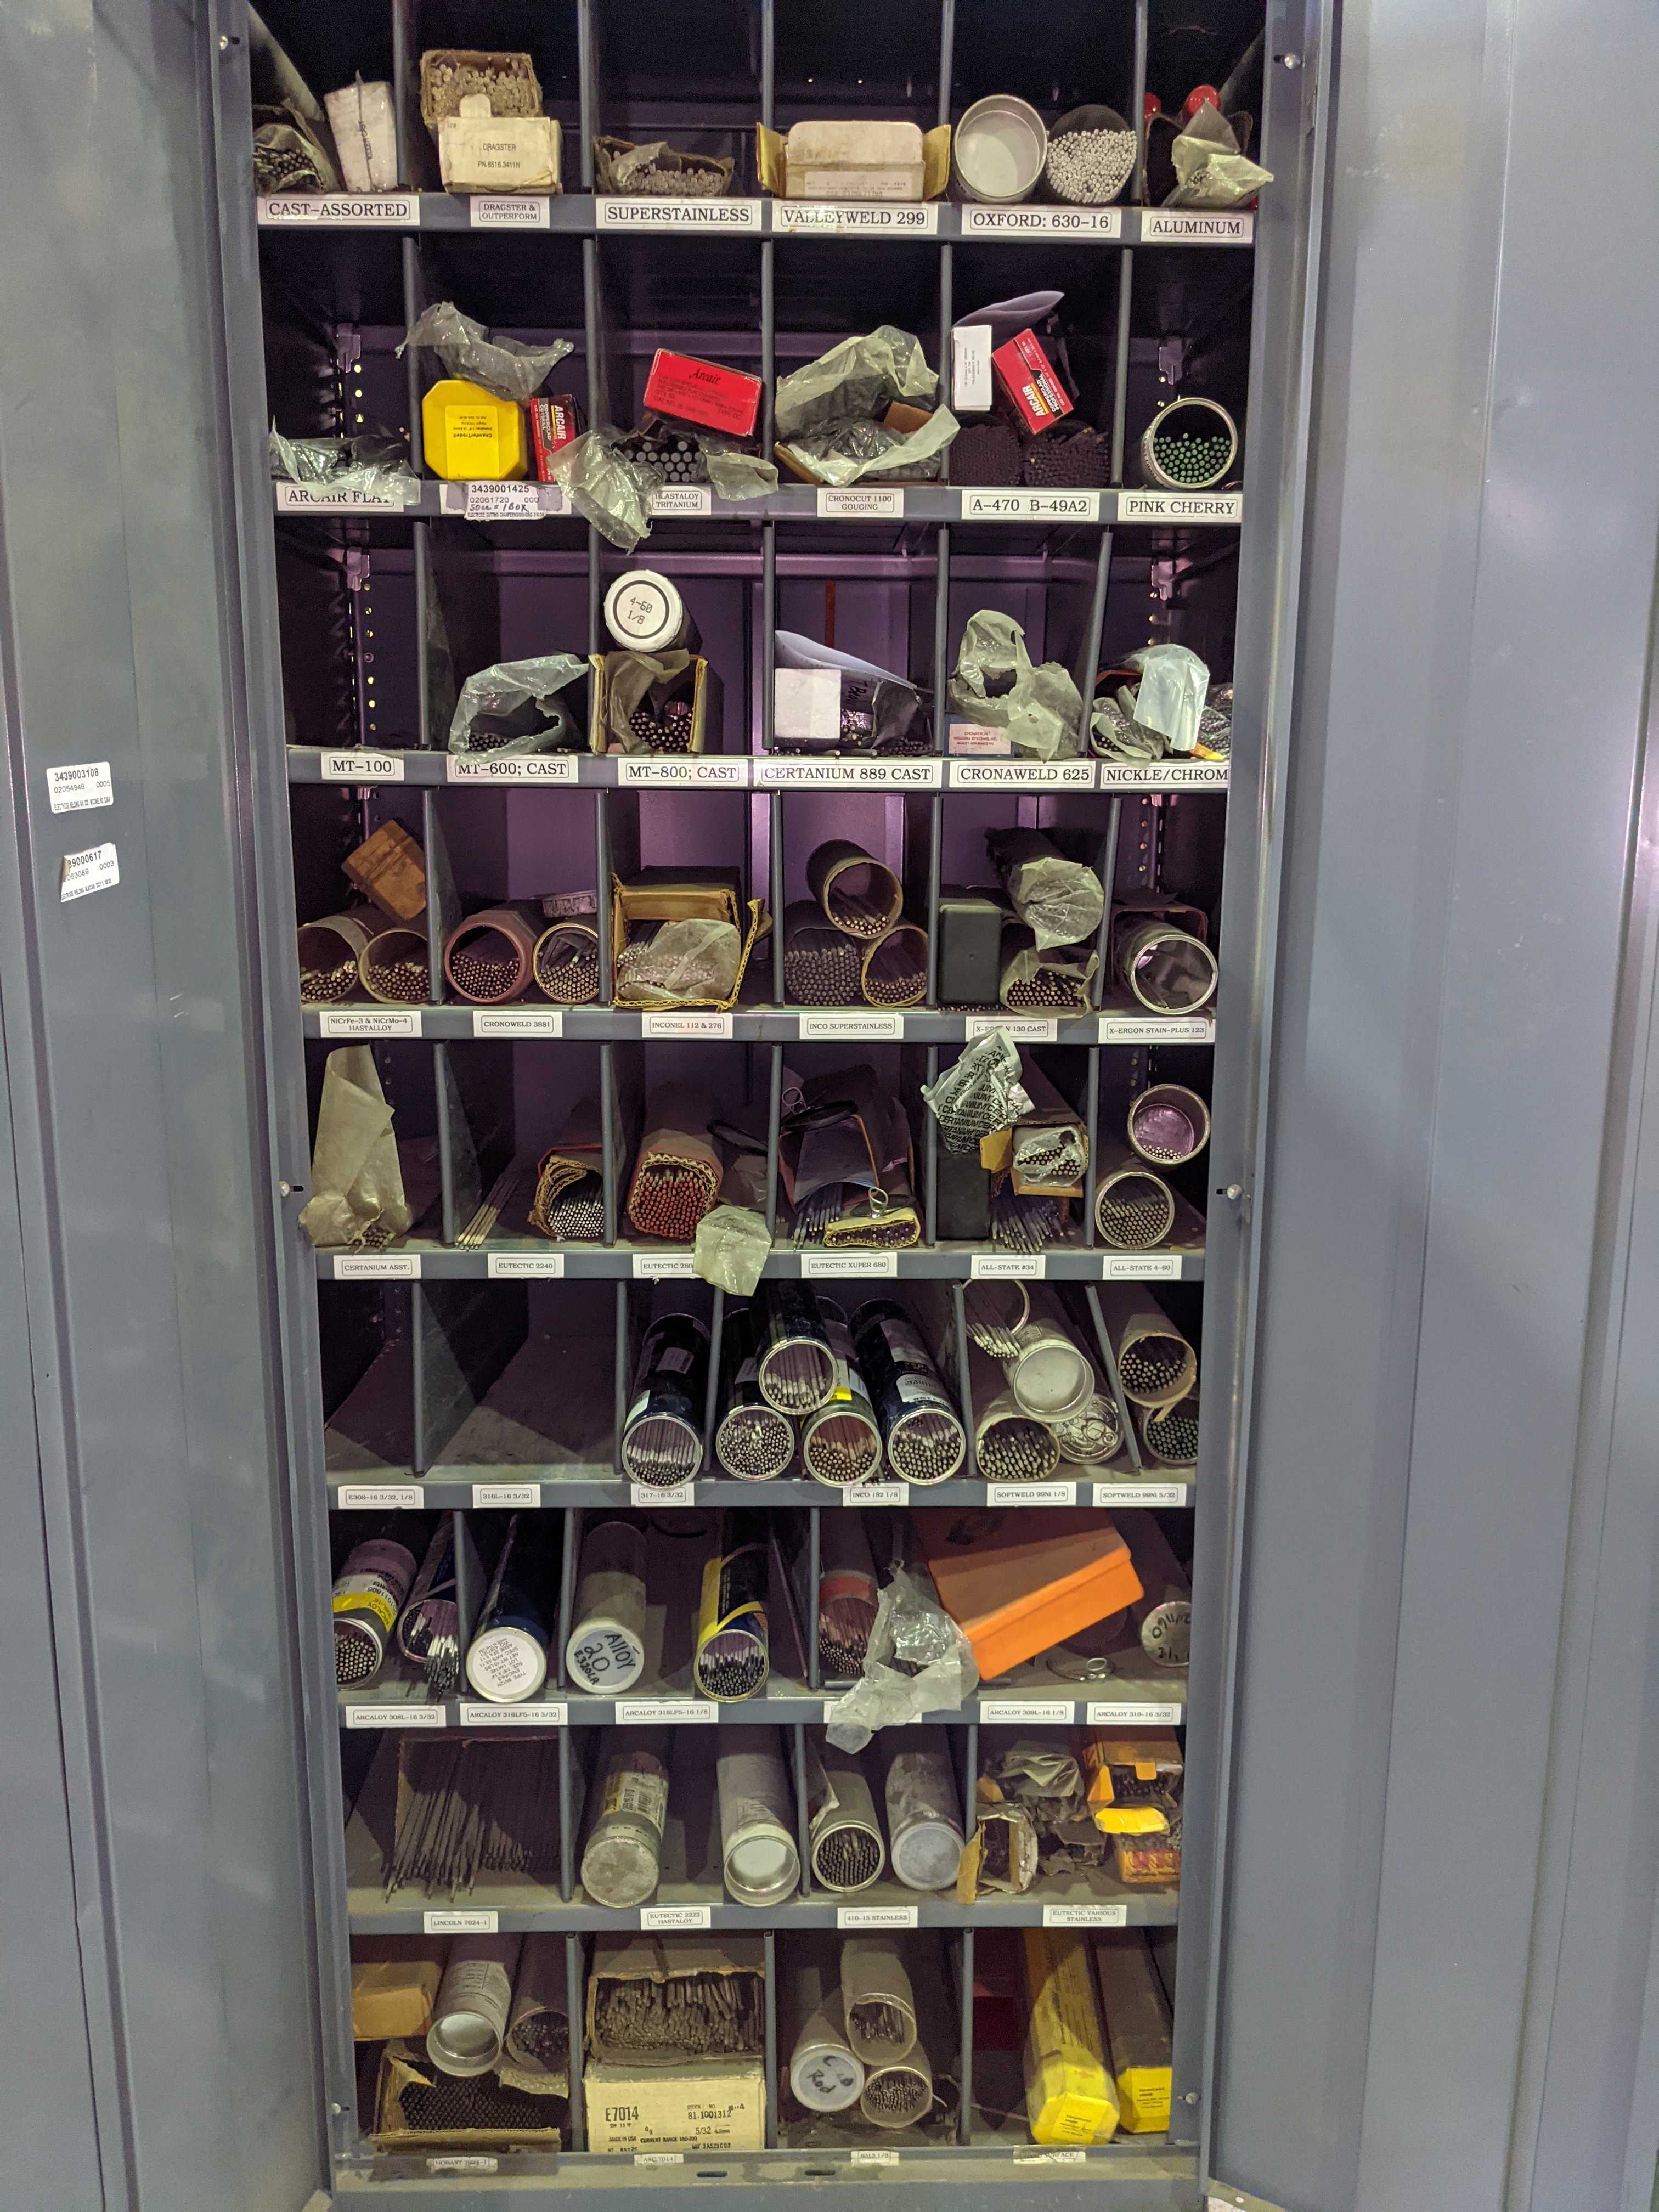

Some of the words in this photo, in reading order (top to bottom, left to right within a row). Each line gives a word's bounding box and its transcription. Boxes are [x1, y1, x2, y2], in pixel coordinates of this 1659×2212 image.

[269, 202, 408, 217] CAST-ASSORTED
[483, 203, 526, 212] DRAGSTER
[482, 212, 537, 221] OUTPERFORM
[607, 207, 749, 222] SUPERSTAINLESS
[783, 210, 891, 224] VALLEYWELD
[896, 212, 925, 225] 299
[973, 213, 1046, 228] OXFORD:
[1051, 215, 1109, 229] 630-16
[1153, 220, 1240, 234] ALUMINUM
[1022, 385, 1046, 416] ARCAIR
[554, 405, 566, 439] ARCAIR
[472, 484, 529, 493] 3439001425
[841, 503, 878, 511] GOUGING
[972, 499, 1020, 512] A-470
[1029, 500, 1087, 512] B-49A2
[1129, 501, 1165, 513] PINK
[1170, 501, 1235, 515] CHERRY
[630, 596, 653, 613] 4-60
[627, 610, 645, 625] 1/8
[332, 760, 392, 773] MT-100
[458, 763, 522, 776] MT-600;
[526, 763, 566, 775] CAST
[629, 766, 693, 780] MT-800;
[697, 767, 737, 779] CAST
[54, 768, 99, 781] 3439003108
[765, 768, 855, 780] CERTANIUM
[860, 768, 887, 780] 889
[890, 769, 931, 780] CAST
[961, 769, 1058, 781] CRONAWELD
[1063, 769, 1090, 781] 625
[1106, 770, 1228, 782] NICKLE/CHROM
[96, 780, 111, 788] 0005
[99, 860, 114, 870] 0003
[584, 1645, 610, 1672] 20
[605, 2106, 639, 2121] E7014
[696, 2126, 712, 2135] 5/32
